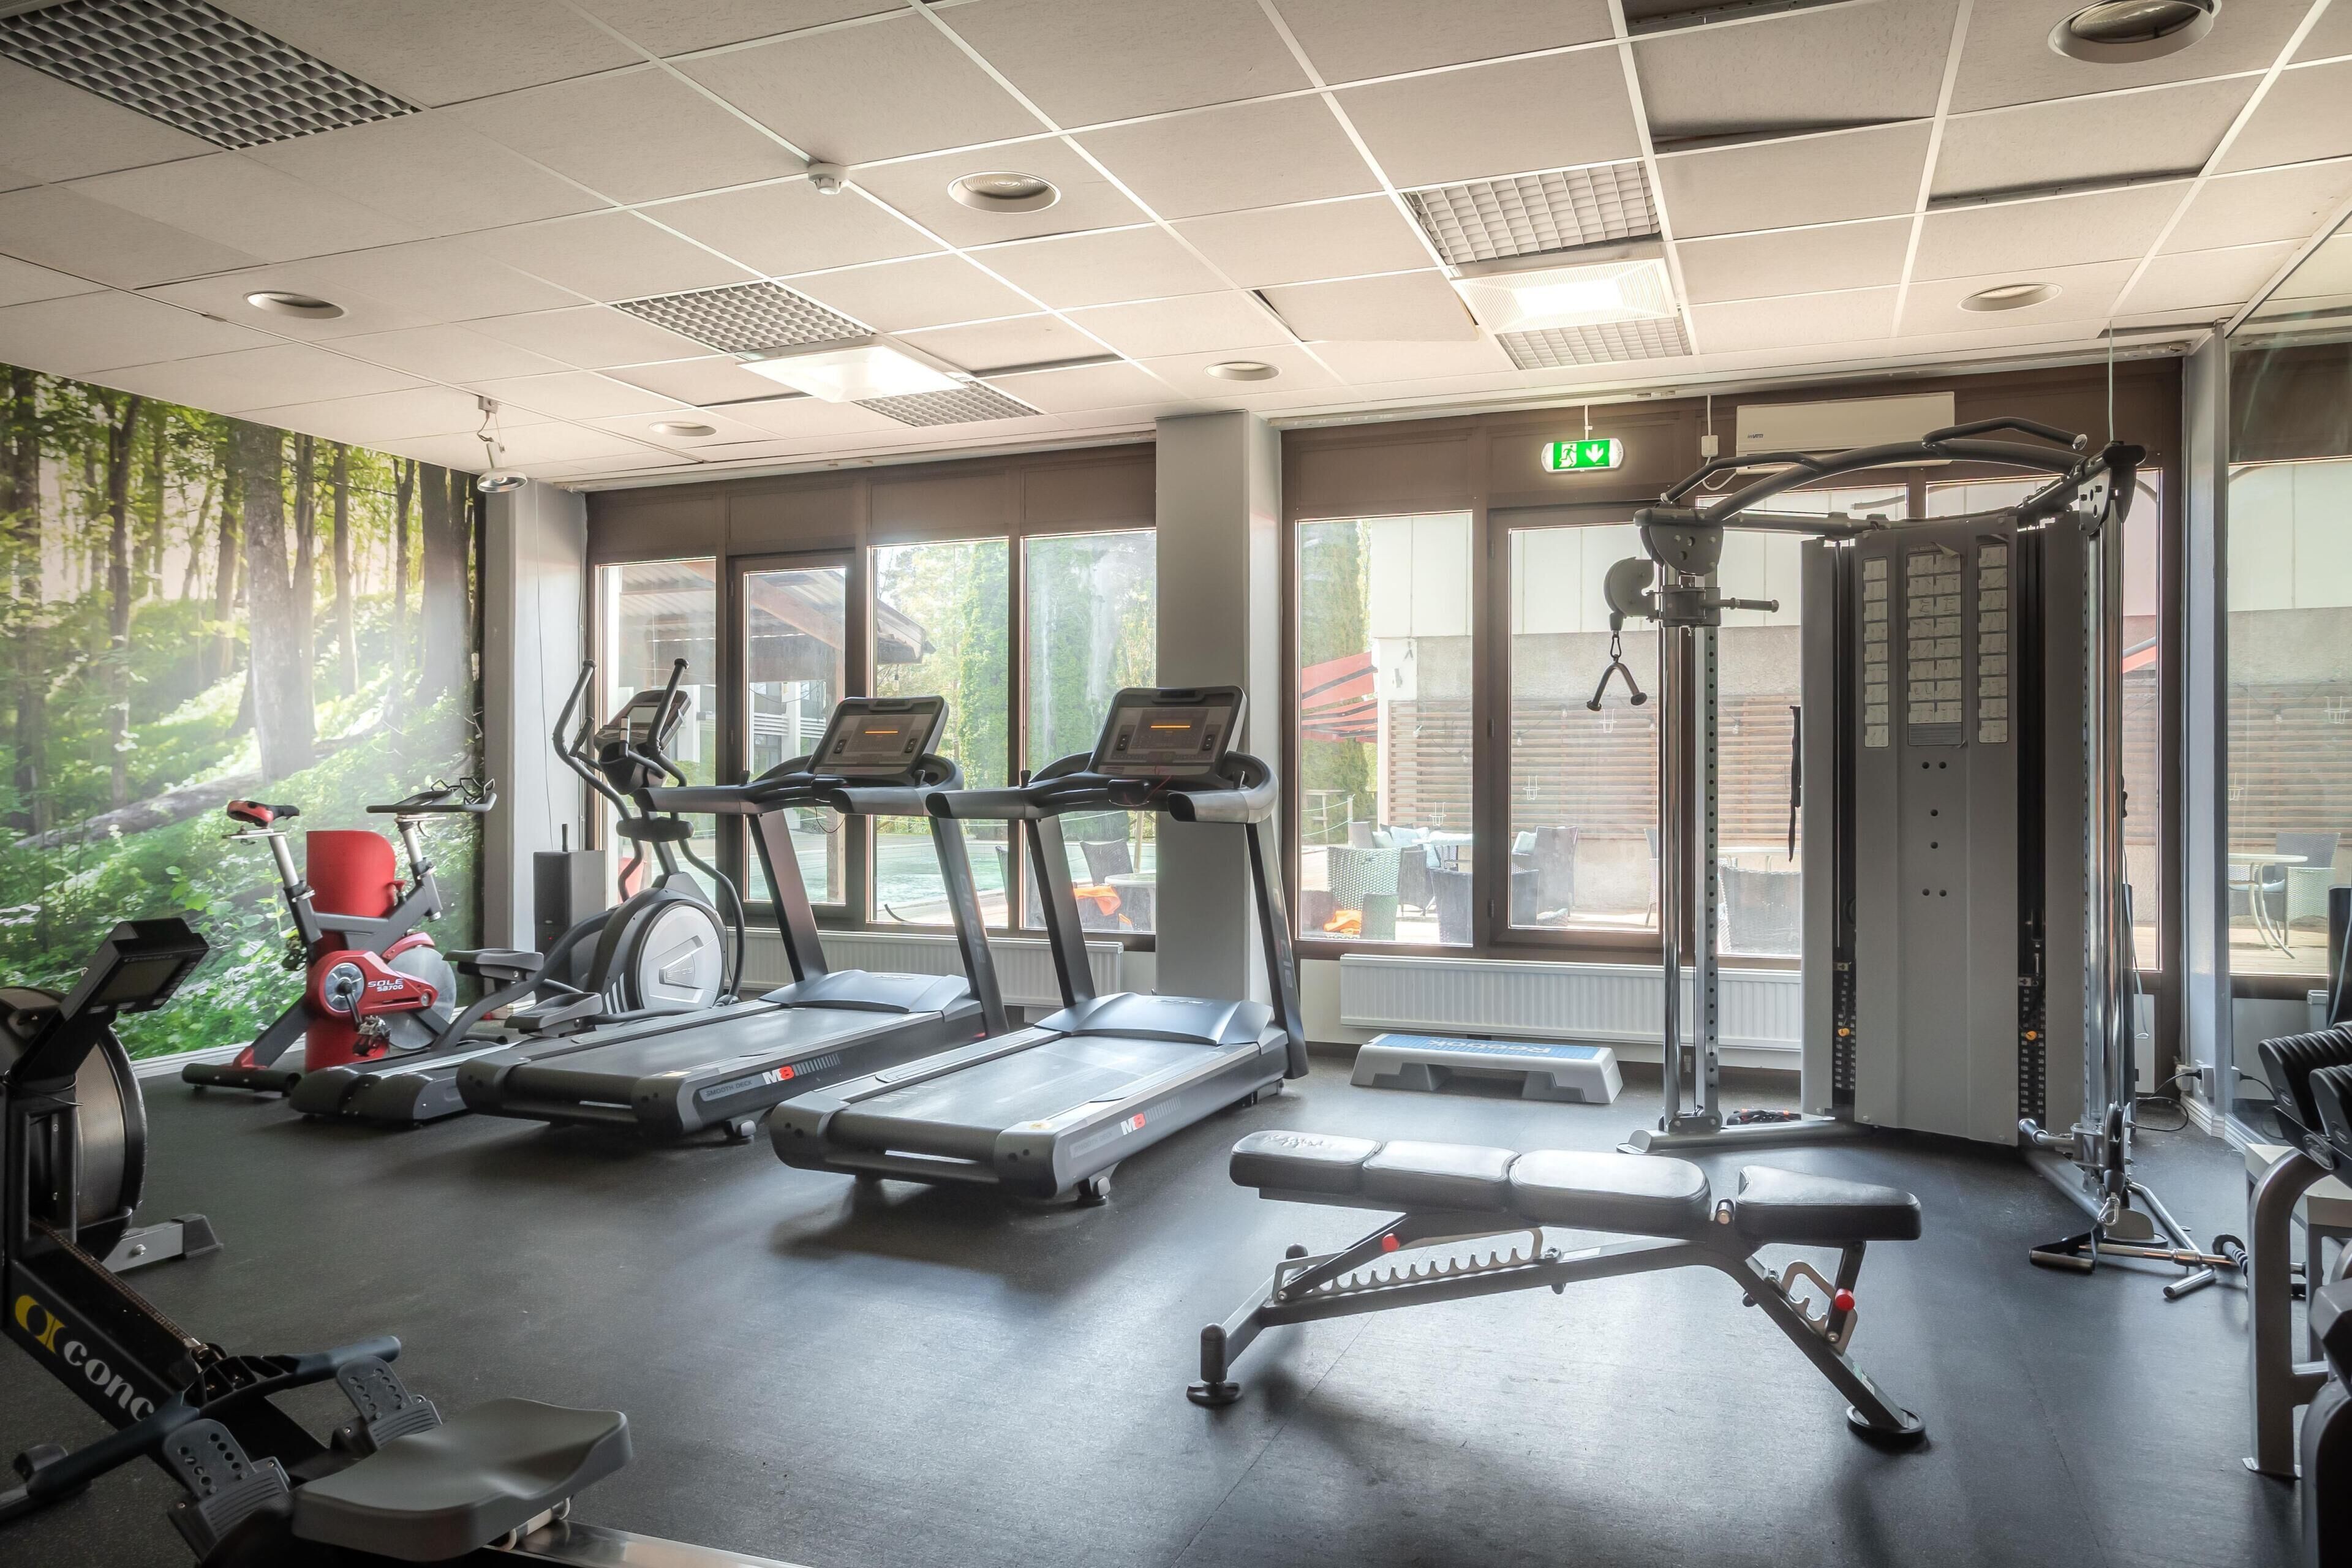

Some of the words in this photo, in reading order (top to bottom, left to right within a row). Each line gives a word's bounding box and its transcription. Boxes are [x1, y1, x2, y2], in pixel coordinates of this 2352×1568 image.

[368, 978, 404, 987] SOLE
[1427, 1039, 1551, 1054] Reebok
[762, 1066, 794, 1084] M8
[706, 1085, 734, 1096] SMOOTH
[736, 1080, 752, 1088] DECK
[1120, 1113, 1146, 1136] M8
